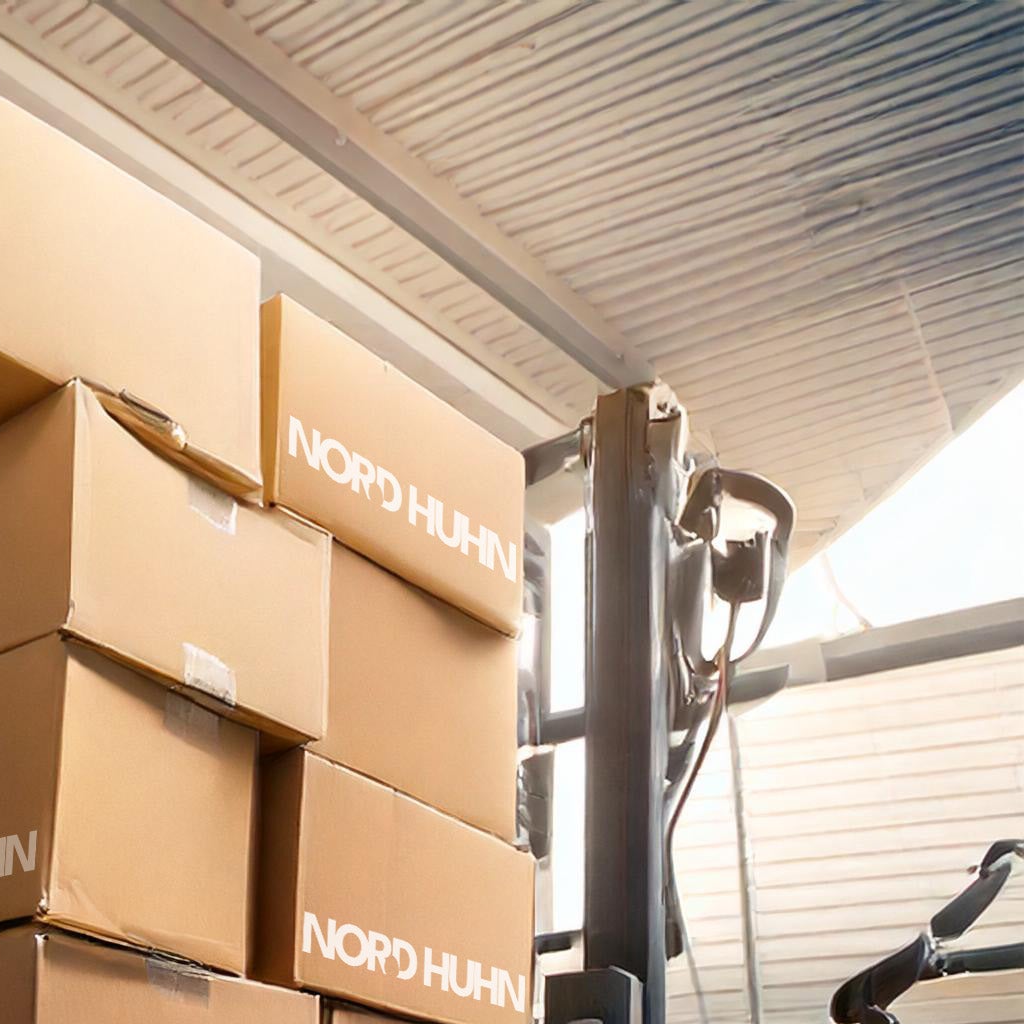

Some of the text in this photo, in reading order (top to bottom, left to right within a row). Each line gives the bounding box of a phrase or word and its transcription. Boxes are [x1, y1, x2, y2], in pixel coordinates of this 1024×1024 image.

[288, 415, 516, 583] NORD HUHN
[302, 911, 525, 1013] NORD HUHN
